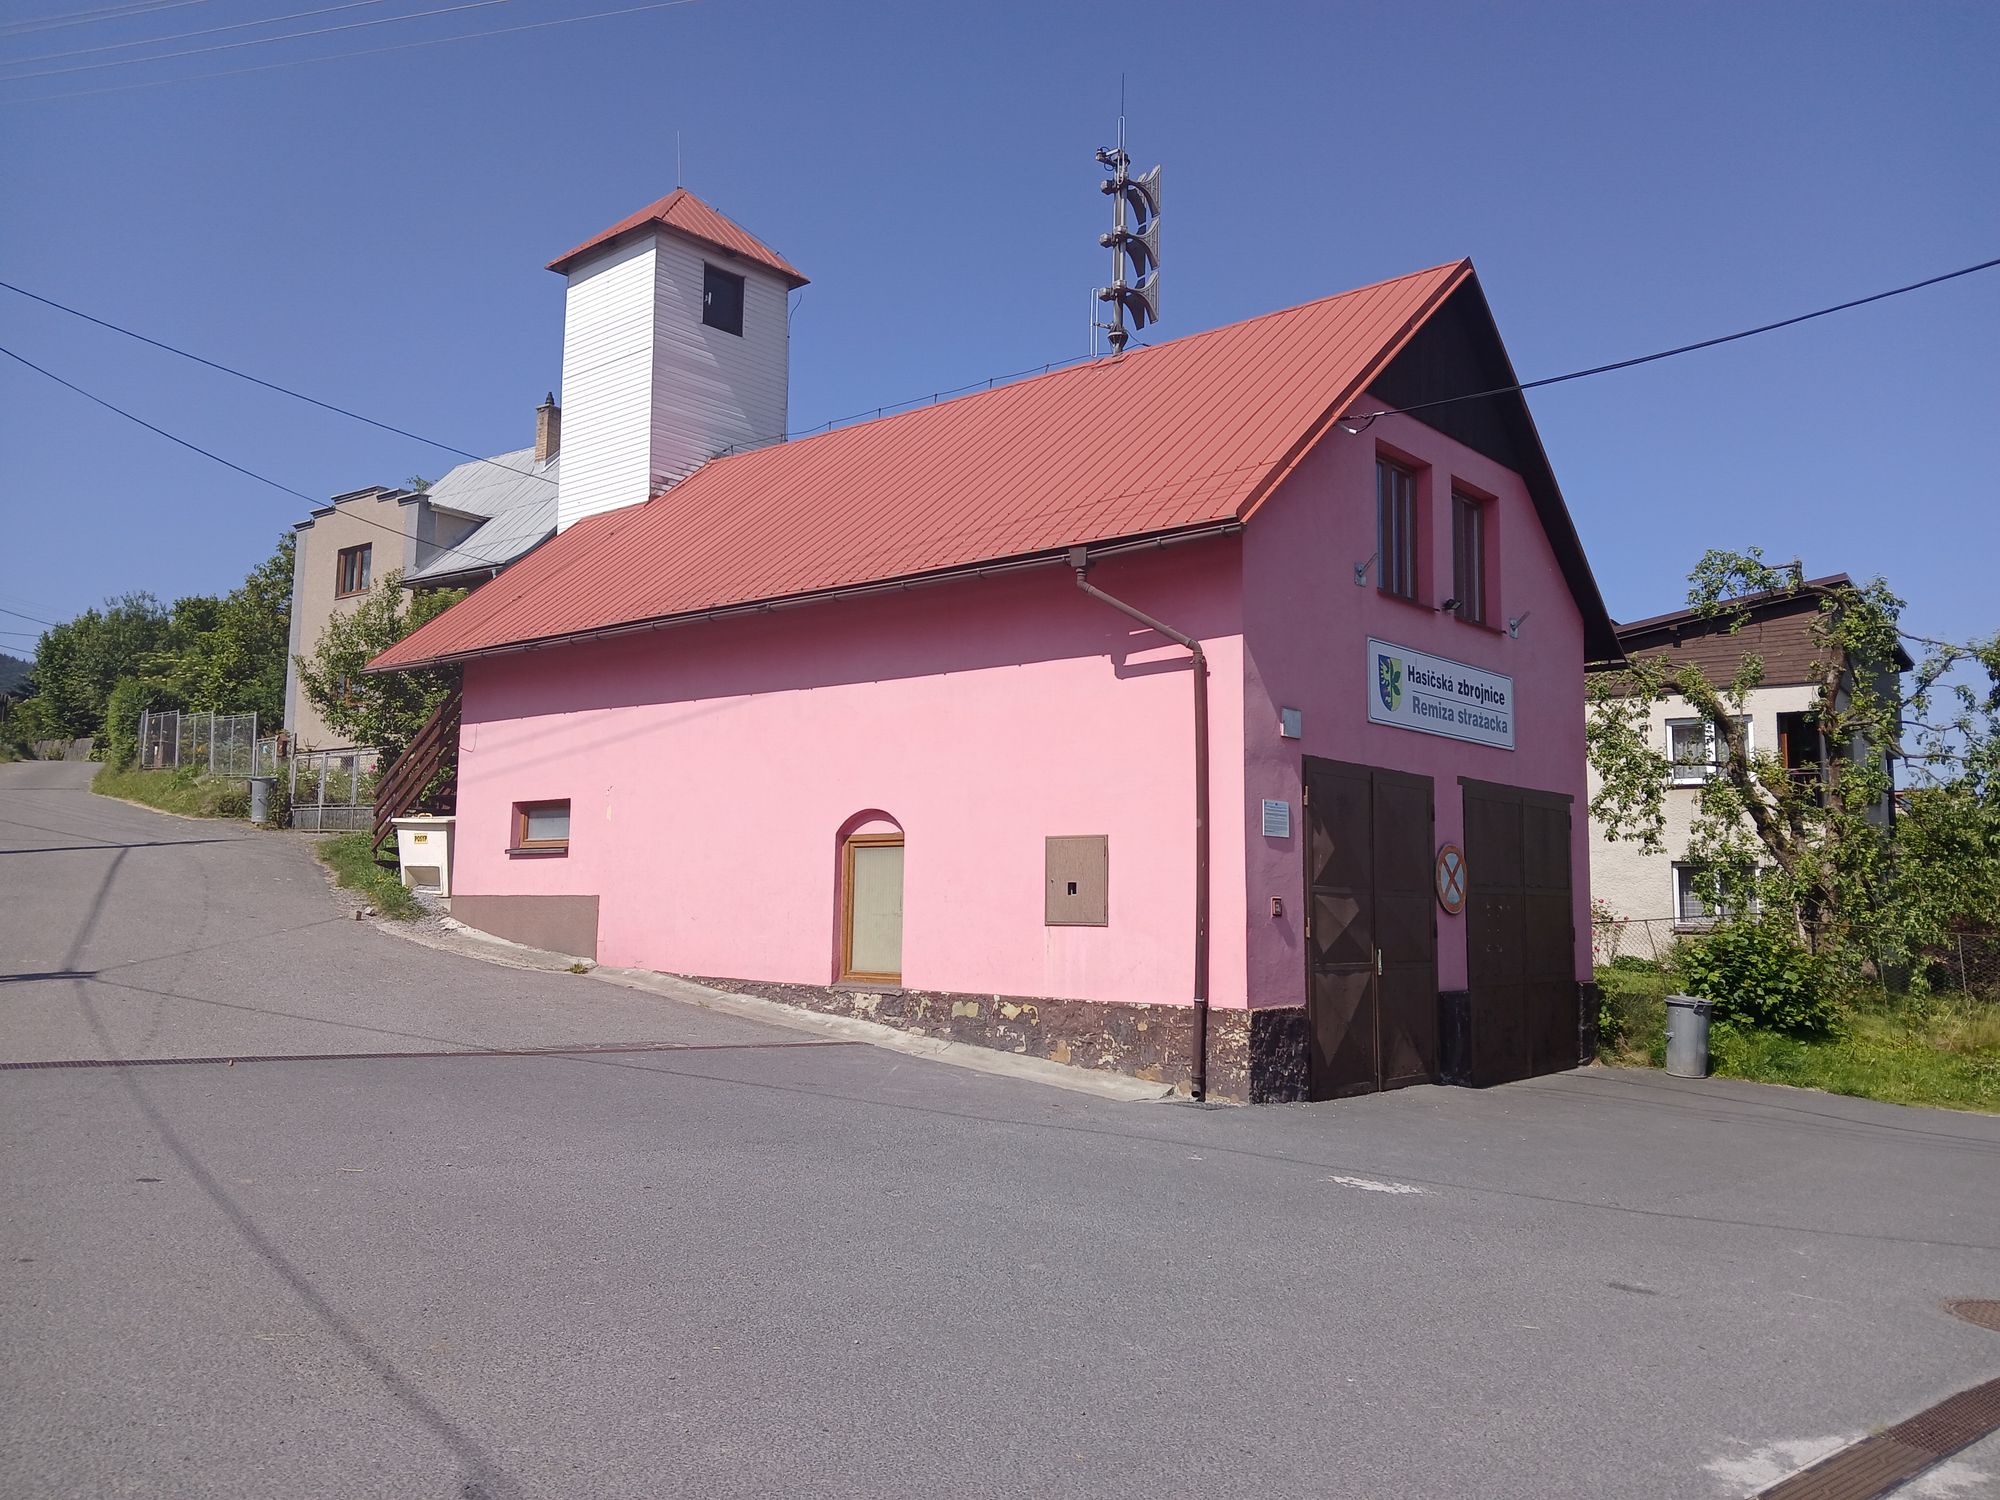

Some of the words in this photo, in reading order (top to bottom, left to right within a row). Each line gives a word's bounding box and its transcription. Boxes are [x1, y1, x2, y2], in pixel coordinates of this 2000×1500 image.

[1408, 665, 1453, 692] Hasičská
[1457, 679, 1505, 705] zbrojnice
[1412, 695, 1454, 722] Remiza
